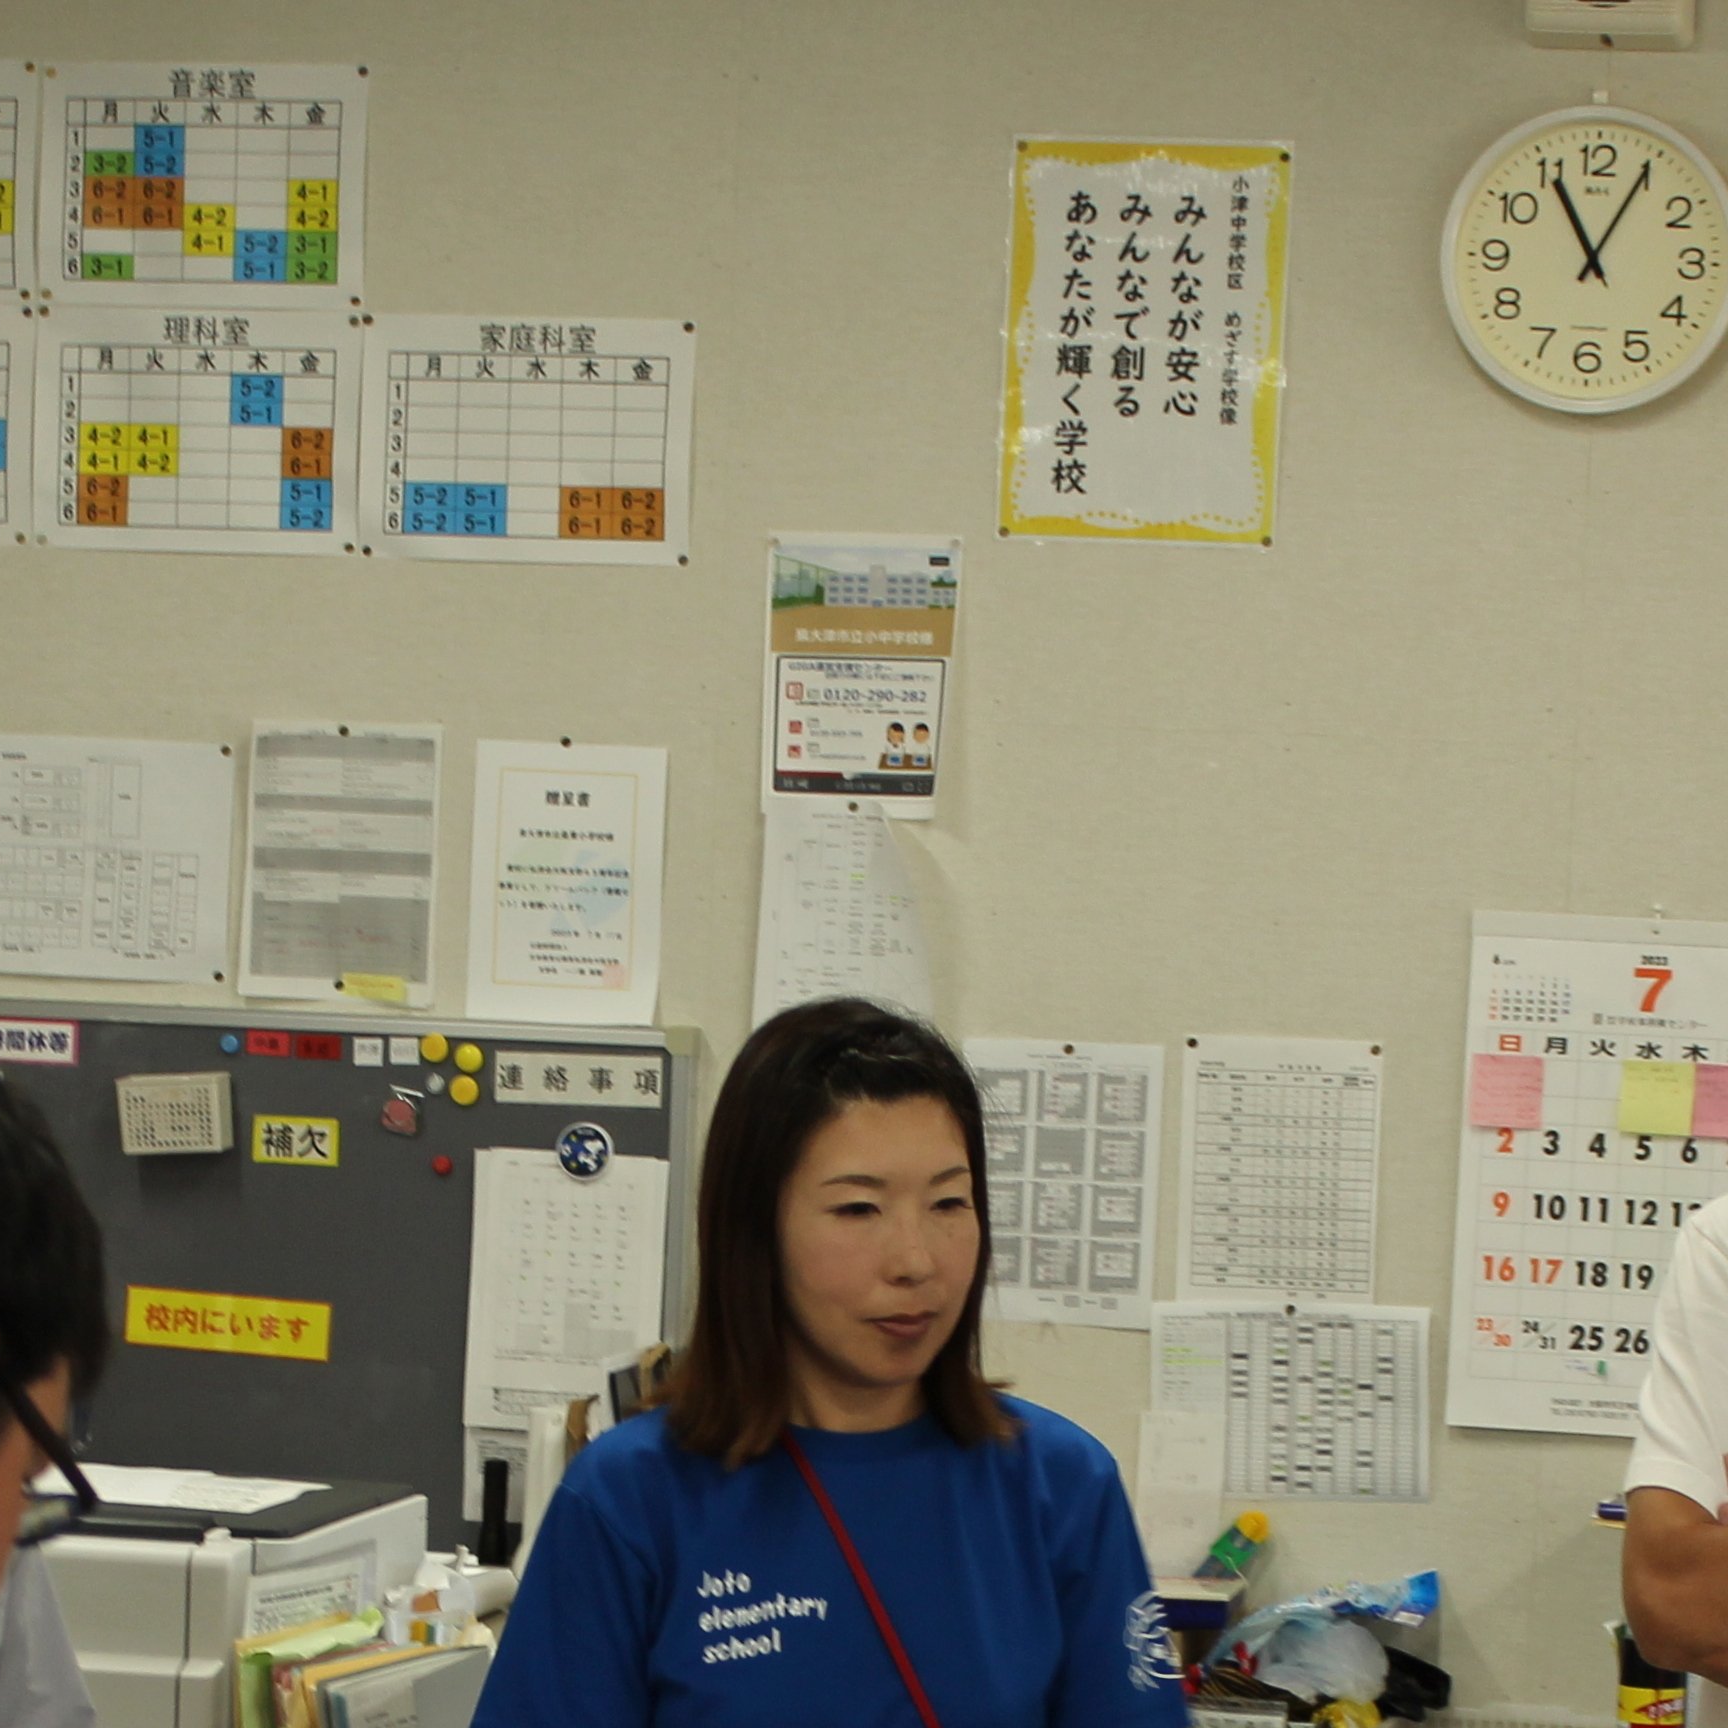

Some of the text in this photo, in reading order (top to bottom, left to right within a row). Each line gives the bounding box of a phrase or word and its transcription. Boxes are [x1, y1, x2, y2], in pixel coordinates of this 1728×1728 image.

[169, 68, 256, 100] 音楽室
[144, 128, 175, 149] 5-1
[94, 154, 127, 174] 3-2
[1537, 157, 1564, 189] 11
[1579, 144, 1618, 177] 12
[1640, 160, 1652, 191] 1
[143, 179, 176, 200] 6-2
[297, 183, 328, 201] 4-1
[143, 205, 173, 225] 6-1
[193, 207, 227, 226] 4-2
[297, 209, 330, 228] 4-2
[1498, 191, 1539, 225] 10
[1665, 196, 1693, 230] 2
[192, 233, 224, 250] 4-1
[244, 234, 279, 254] 5-2
[295, 234, 327, 254] 3-1
[1481, 238, 1510, 272] 9
[1676, 247, 1706, 280] 3
[244, 260, 276, 279] 5-1
[295, 261, 329, 280] 3-2
[1109, 193, 1153, 418] みんなで創る
[1162, 195, 1208, 417] みんなが安心
[1493, 287, 1522, 320] 8
[1659, 294, 1688, 327] 4
[163, 316, 250, 347] 理科室
[479, 323, 596, 355] 家庭科室
[1050, 190, 1097, 495] あなたが輝く学校
[1528, 325, 1557, 360] 7
[1573, 341, 1602, 374] 6
[1621, 330, 1651, 363] 5
[241, 377, 276, 398] 5-2
[240, 404, 272, 423] 5-1
[88, 427, 122, 445] 4-2
[138, 428, 168, 445] 4-1
[291, 431, 325, 450] 6-2
[88, 453, 119, 470] 4-1
[138, 454, 170, 472] 4-2
[290, 457, 322, 476] 6-1
[291, 482, 322, 501] 5-1
[414, 487, 448, 506] 5-2
[465, 488, 497, 506] 5-1
[569, 490, 602, 508] 6-1
[622, 491, 656, 510] 6-2
[87, 502, 118, 522] 6-1
[290, 508, 324, 528] 5-2
[412, 513, 447, 531] 5-2
[464, 513, 496, 532] 5-1
[568, 516, 601, 534] 6-1
[621, 517, 656, 536] 6-2
[1633, 967, 1673, 1014] 7
[1498, 1033, 1522, 1052] 日
[1544, 1036, 1568, 1055] 月
[1589, 1038, 1617, 1058] 火
[1635, 1041, 1663, 1060] 水
[1681, 1043, 1710, 1061] 木
[495, 1063, 662, 1100] 連絡事項
[260, 1122, 330, 1160] 補欠
[1496, 1128, 1514, 1154] 2
[1542, 1129, 1561, 1156] 3
[1588, 1132, 1607, 1159] 4
[1634, 1136, 1652, 1161] 5
[1680, 1137, 1698, 1165] 6
[1493, 1192, 1510, 1218] 9
[1532, 1193, 1567, 1221] 10
[1578, 1195, 1610, 1224] 11
[1624, 1198, 1658, 1227] 12
[1481, 1255, 1516, 1282] 16
[1528, 1258, 1563, 1285] 17
[1575, 1260, 1608, 1288] 18
[1620, 1263, 1654, 1291] 19
[143, 1303, 311, 1344] 校内にいます
[1476, 1317, 1495, 1332] 23
[1521, 1320, 1540, 1335] 24
[1493, 1333, 1512, 1347] 30
[1539, 1335, 1556, 1350] 31
[1568, 1324, 1605, 1352] 25
[1613, 1327, 1650, 1355] 26
[695, 1568, 751, 1599] Joto
[698, 1591, 829, 1634] elementary
[701, 1627, 783, 1665] school
